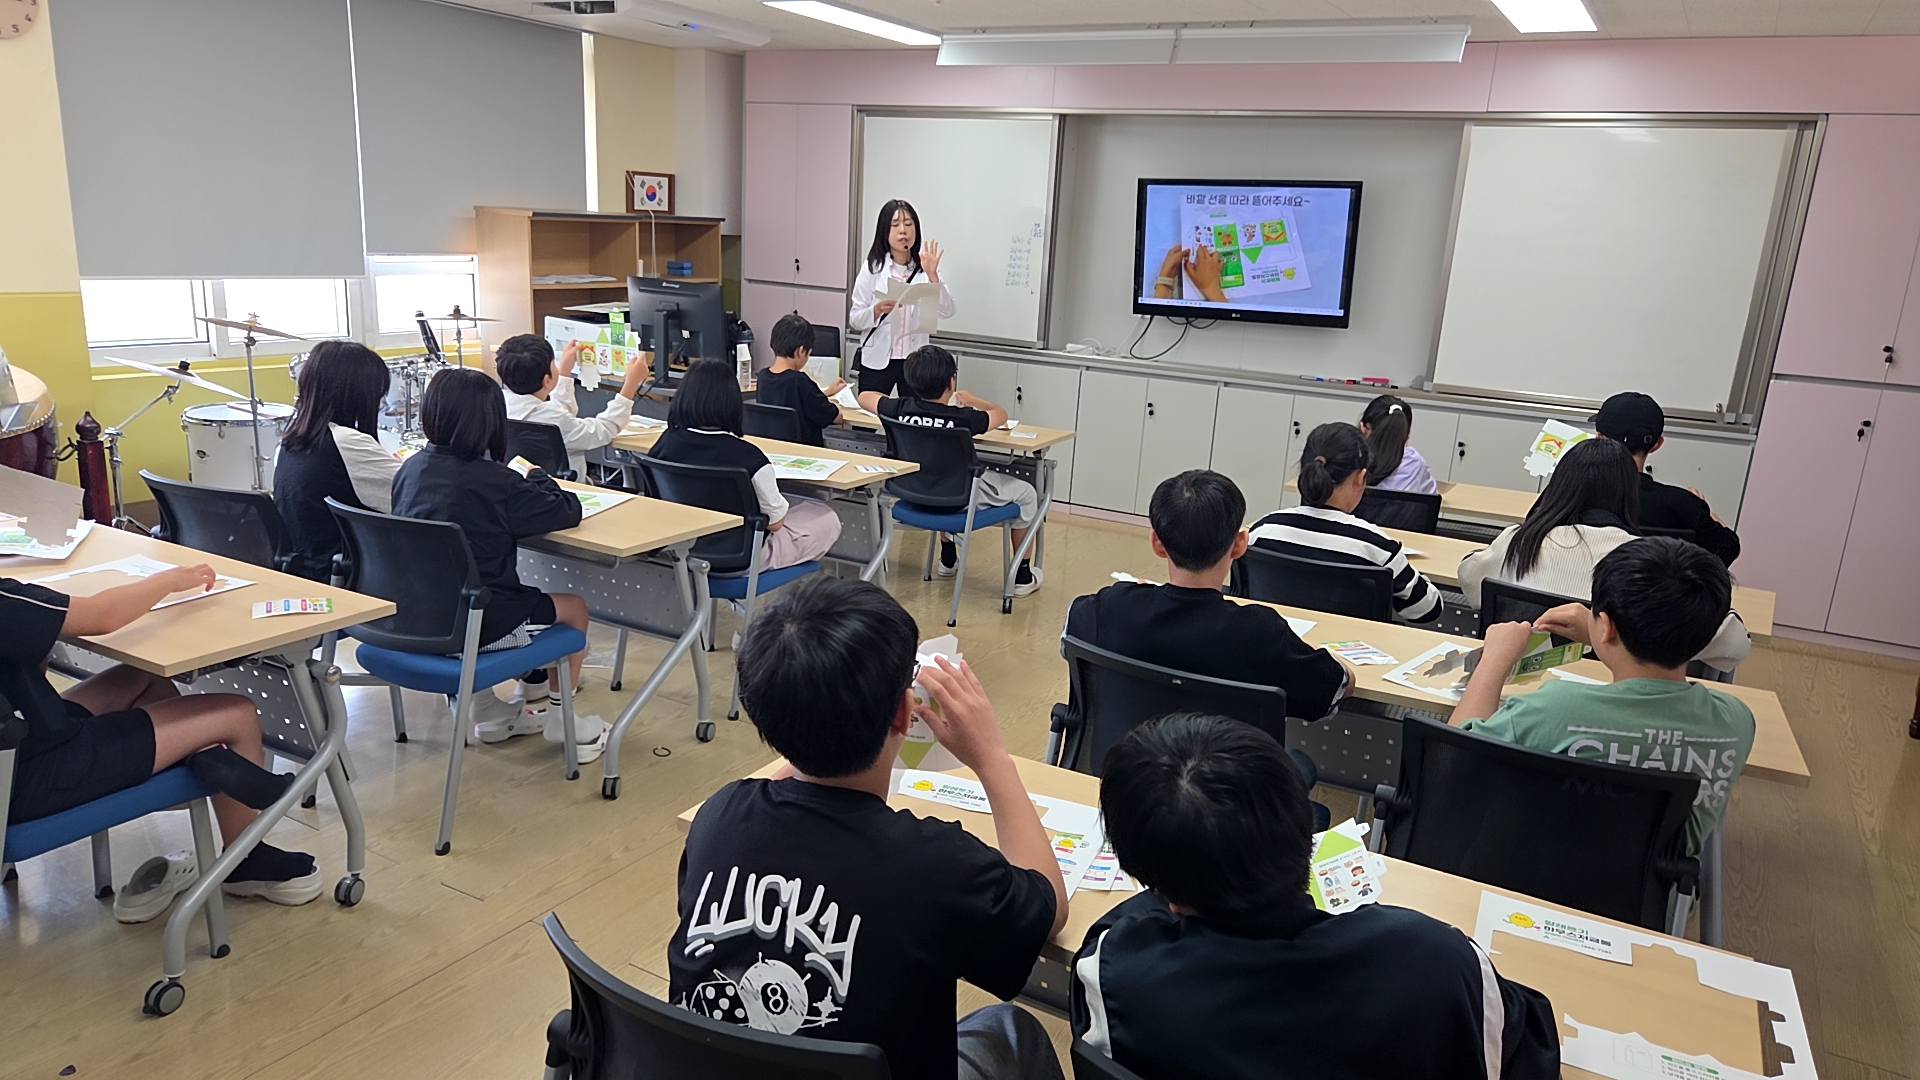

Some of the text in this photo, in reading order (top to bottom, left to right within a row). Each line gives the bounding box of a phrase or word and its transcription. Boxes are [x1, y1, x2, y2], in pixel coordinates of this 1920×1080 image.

[11, 23, 20, 33] 5
[1229, 194, 1250, 206] 따라
[1644, 728, 1684, 746] THE
[1567, 738, 1738, 780] CHAINS
[686, 866, 862, 1001] LUCKY
[766, 983, 782, 1012] 8
